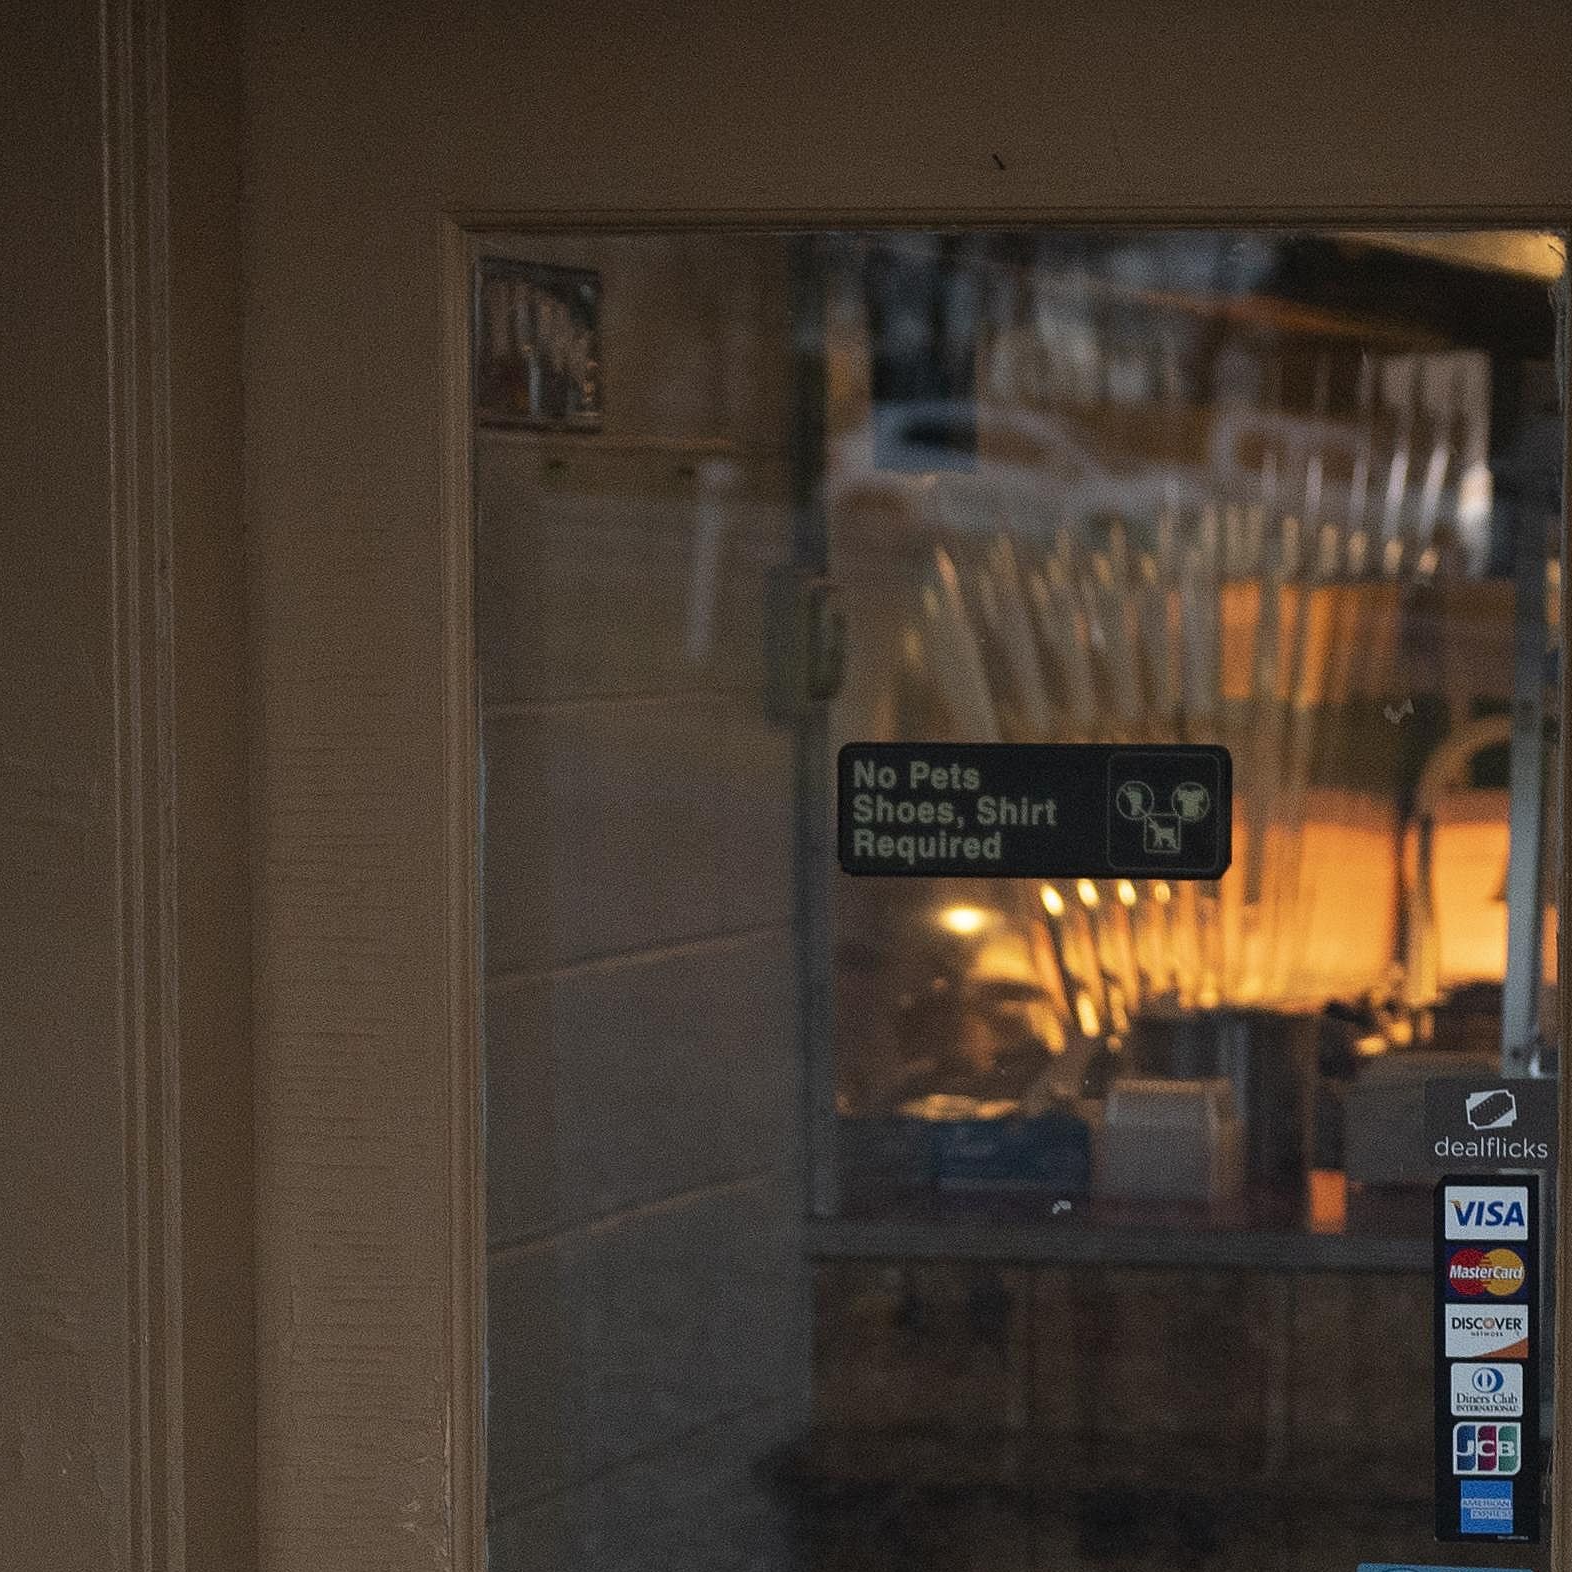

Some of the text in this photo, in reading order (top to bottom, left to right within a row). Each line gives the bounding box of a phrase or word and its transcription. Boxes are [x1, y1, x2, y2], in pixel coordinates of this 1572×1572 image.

[852, 760, 981, 790] No Pets
[853, 795, 1058, 828] Shoes, Shirt
[853, 829, 1004, 864] Required
[1434, 1136, 1549, 1160] dealflicks
[1451, 1200, 1525, 1226] VISA
[1449, 1264, 1524, 1280] MasterCard
[1451, 1317, 1522, 1330] DISCOVER
[1455, 1404, 1518, 1412] INTERNATIONAL
[1456, 1392, 1518, 1404] Diners Club
[1456, 1440, 1516, 1457] JCB
